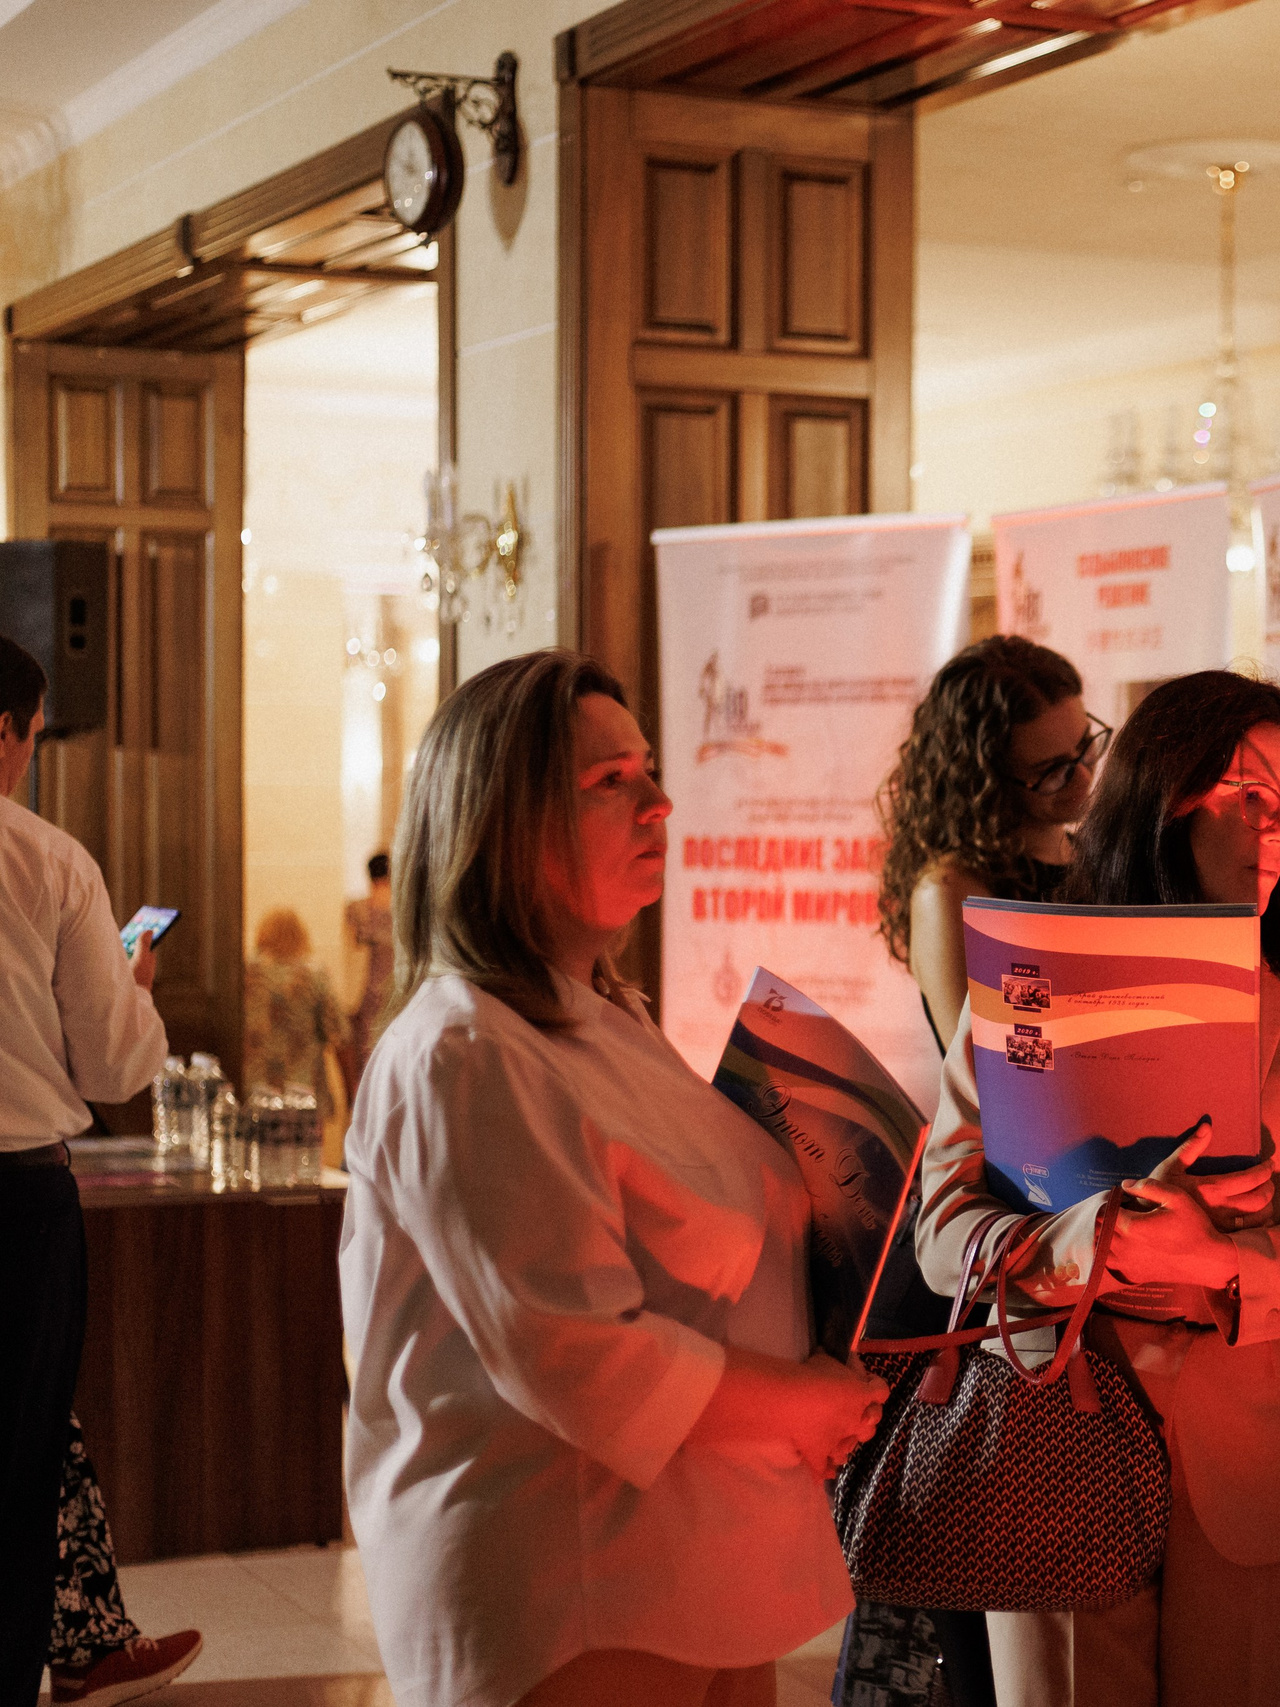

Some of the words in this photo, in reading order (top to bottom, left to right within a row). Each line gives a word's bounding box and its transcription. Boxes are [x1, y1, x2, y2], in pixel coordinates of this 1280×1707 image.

[684, 836, 823, 872] ПОСЛЕДНИЕ
[832, 837, 893, 873] ЗАЛ
[693, 884, 784, 924] ВТОРОЙ
[793, 890, 884, 925] МИРОВ
[1014, 967, 1031, 975] 2019
[762, 988, 787, 1012] 75
[1017, 1027, 1034, 1035] 2020
[748, 1079, 826, 1165] Этот
[828, 1147, 878, 1231] День
